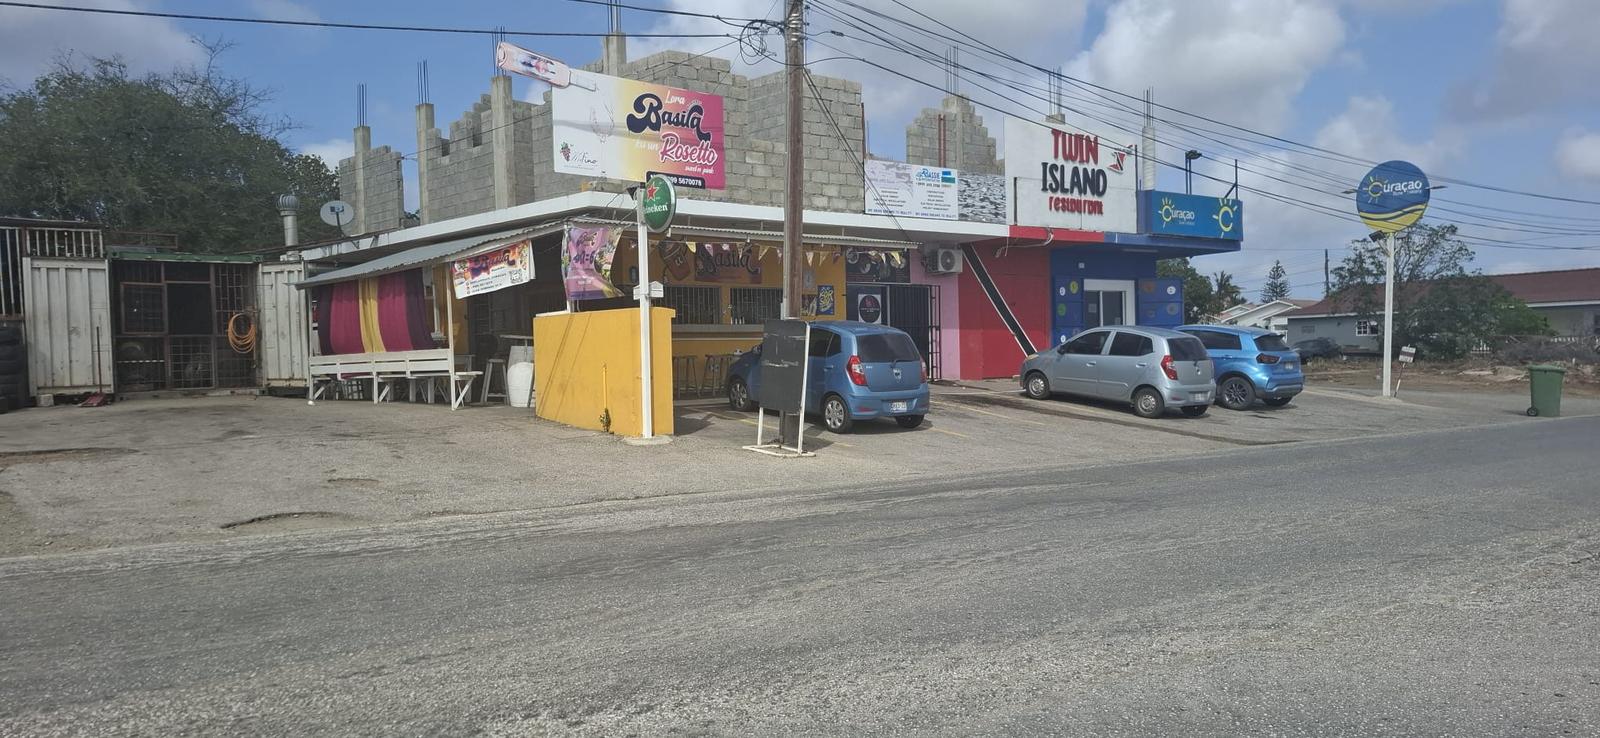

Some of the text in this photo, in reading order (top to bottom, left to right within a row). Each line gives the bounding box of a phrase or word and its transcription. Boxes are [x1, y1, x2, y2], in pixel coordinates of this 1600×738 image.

[626, 93, 711, 142] Basila
[659, 132, 718, 165] Rosetto
[1051, 128, 1099, 165] TWIN
[1041, 162, 1107, 197] ISLAND
[1368, 180, 1422, 198] Curaçao
[1049, 196, 1103, 216] restaurant
[1161, 205, 1195, 223] Curaçao
